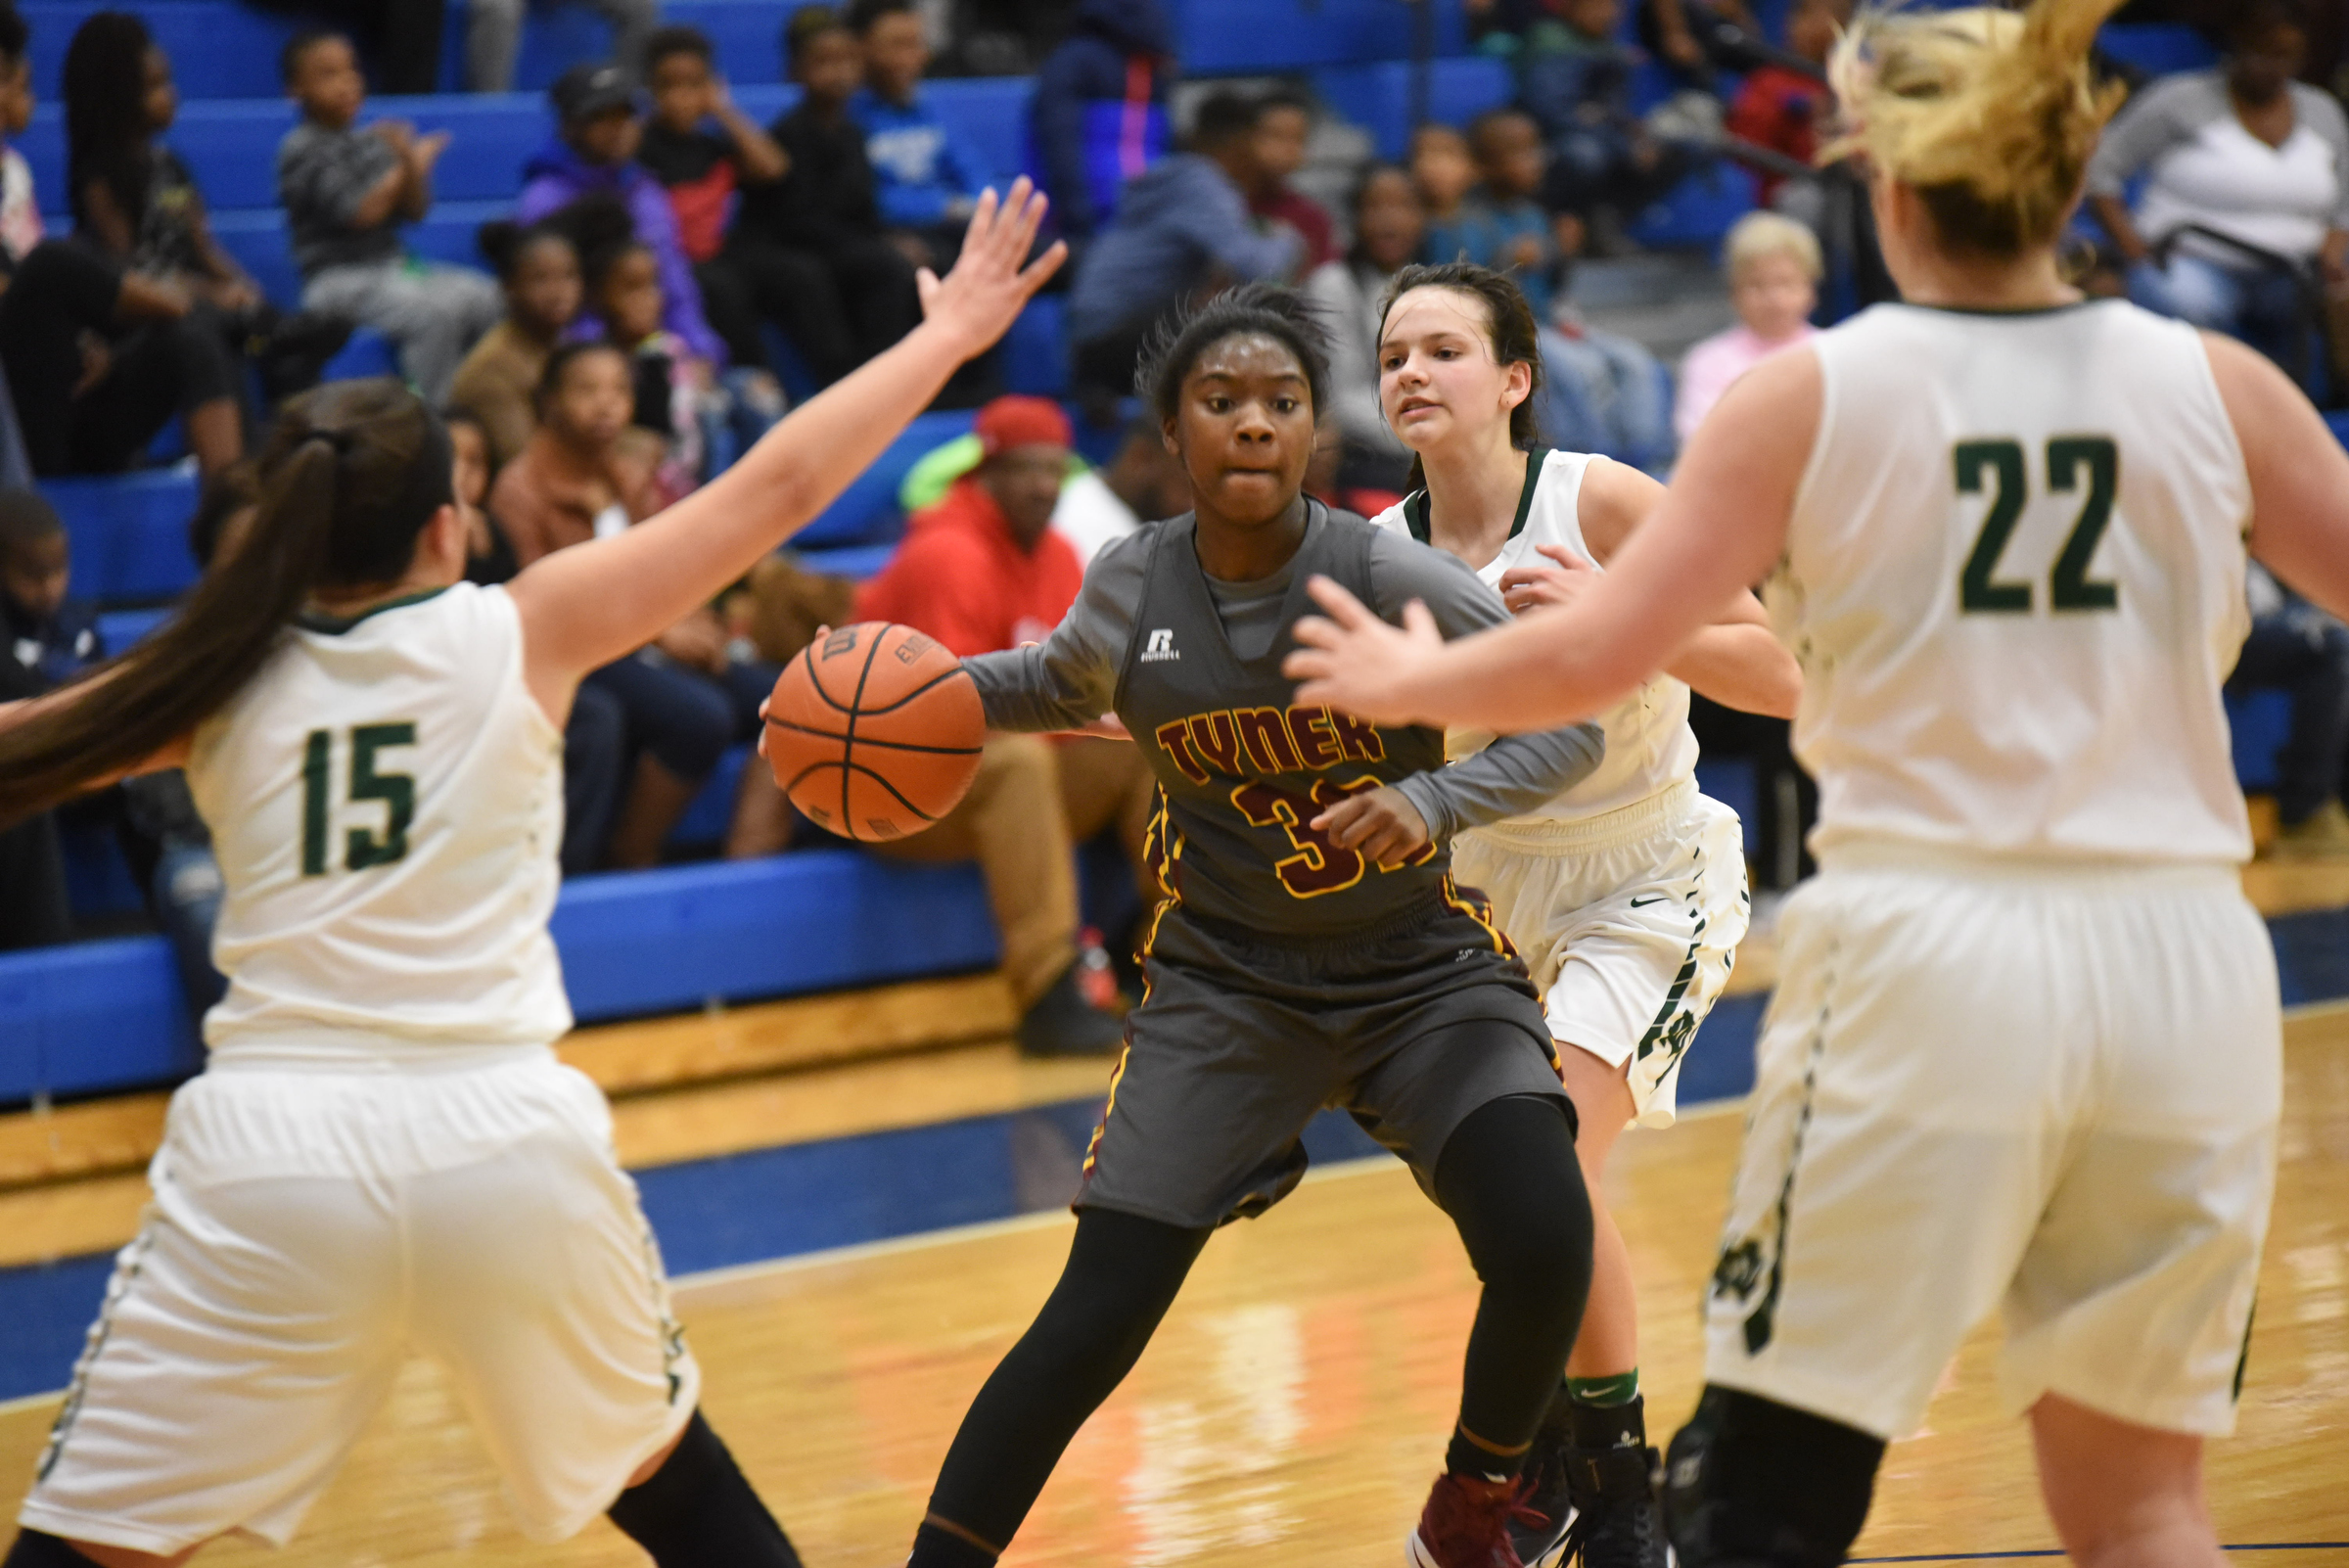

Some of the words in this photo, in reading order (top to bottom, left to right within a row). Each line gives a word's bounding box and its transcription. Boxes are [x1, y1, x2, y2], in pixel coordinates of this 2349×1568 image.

[1952, 436, 2120, 613] 22
[301, 719, 417, 876] 15
[1155, 702, 1387, 786] TYNER
